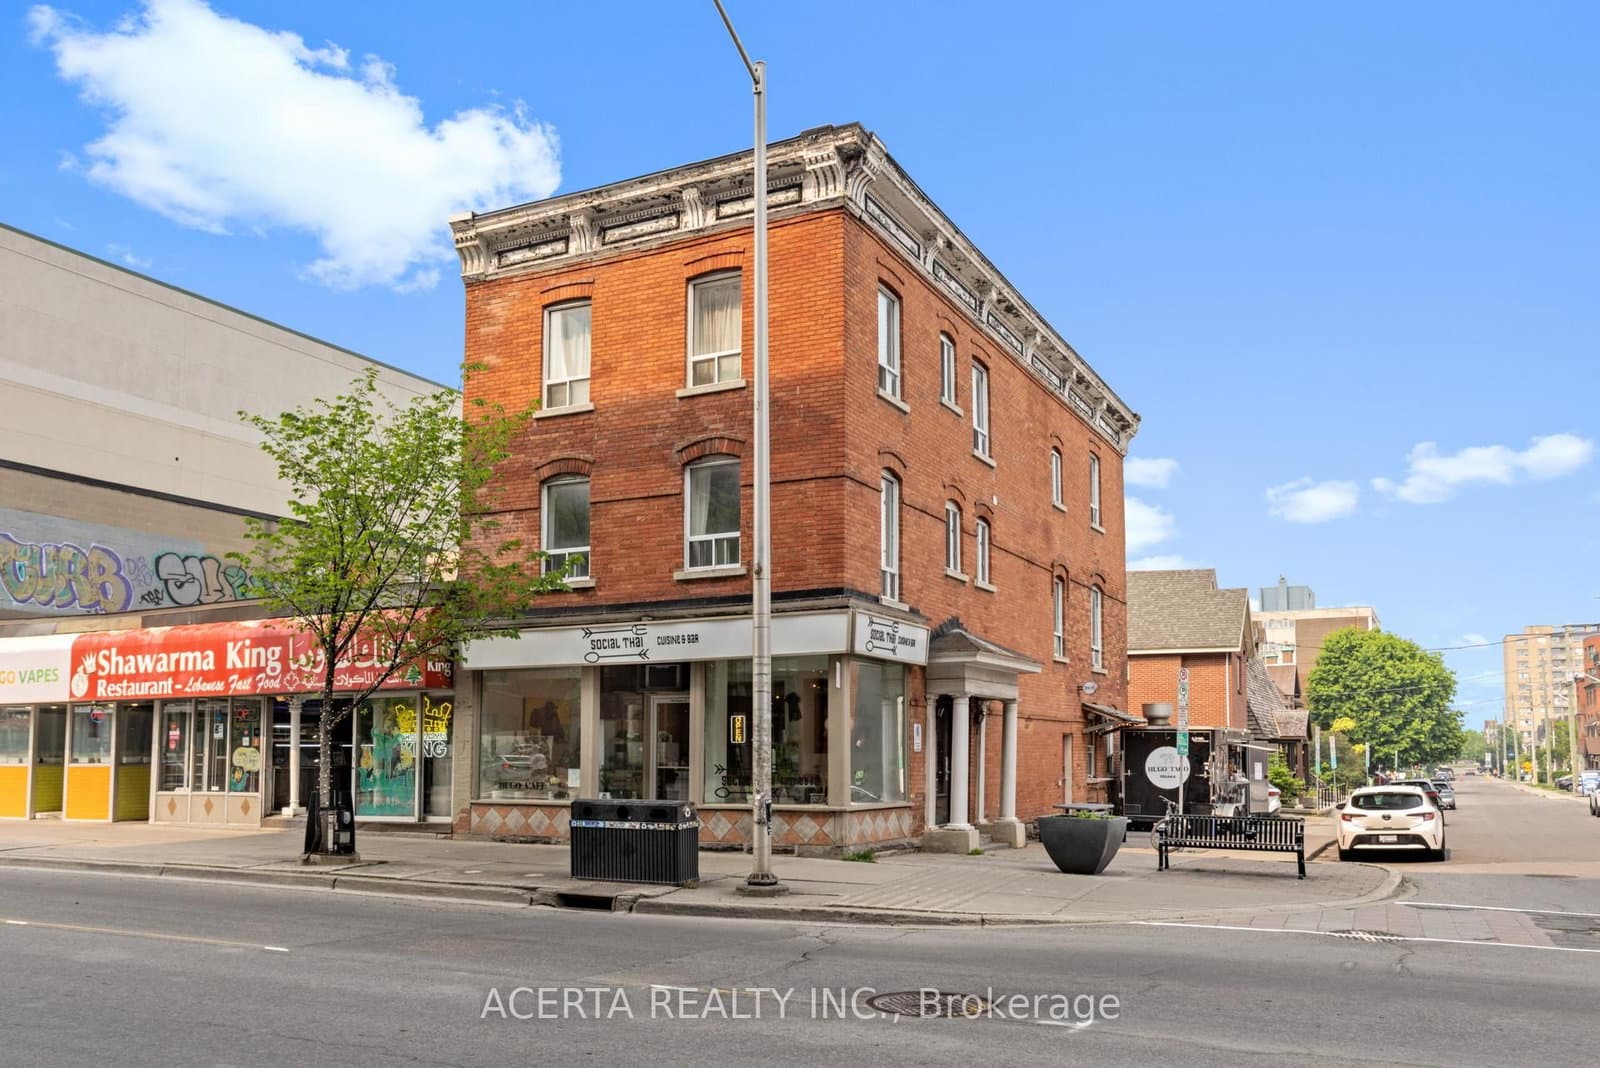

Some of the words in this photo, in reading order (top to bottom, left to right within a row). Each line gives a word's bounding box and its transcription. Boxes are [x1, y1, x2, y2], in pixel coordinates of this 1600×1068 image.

[97, 648, 215, 676] Shawarma
[226, 639, 282, 675] King
[19, 669, 59, 683] VAPES
[427, 661, 452, 677] King
[97, 677, 173, 696] Restaurant
[228, 674, 251, 695] Fast
[255, 674, 282, 693] Food
